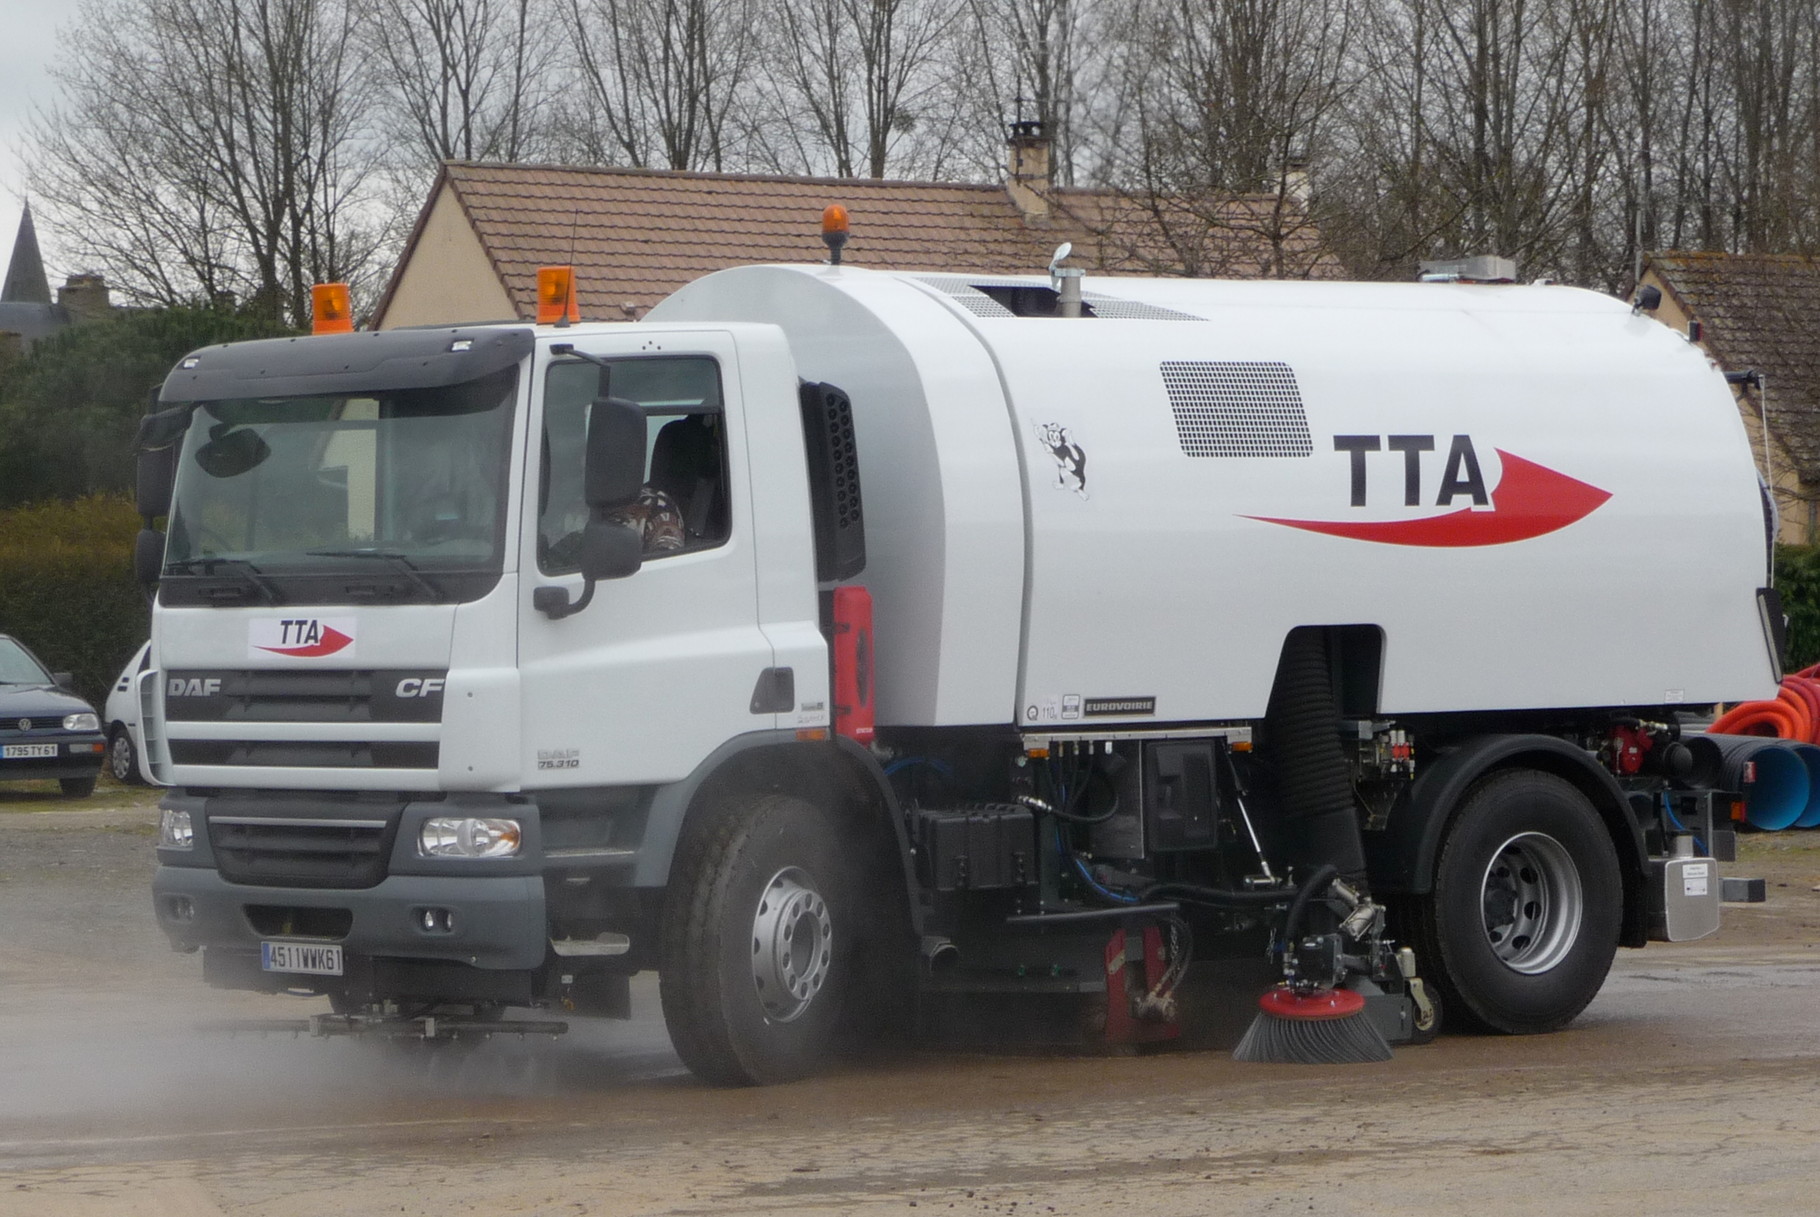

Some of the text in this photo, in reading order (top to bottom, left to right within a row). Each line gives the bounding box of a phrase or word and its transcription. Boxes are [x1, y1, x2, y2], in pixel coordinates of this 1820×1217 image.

[1333, 434, 1489, 507] TTA
[280, 619, 319, 645] TTA
[168, 678, 222, 697] DAF
[395, 677, 445, 698] CF
[1085, 700, 1153, 712] EUROVOIRIE
